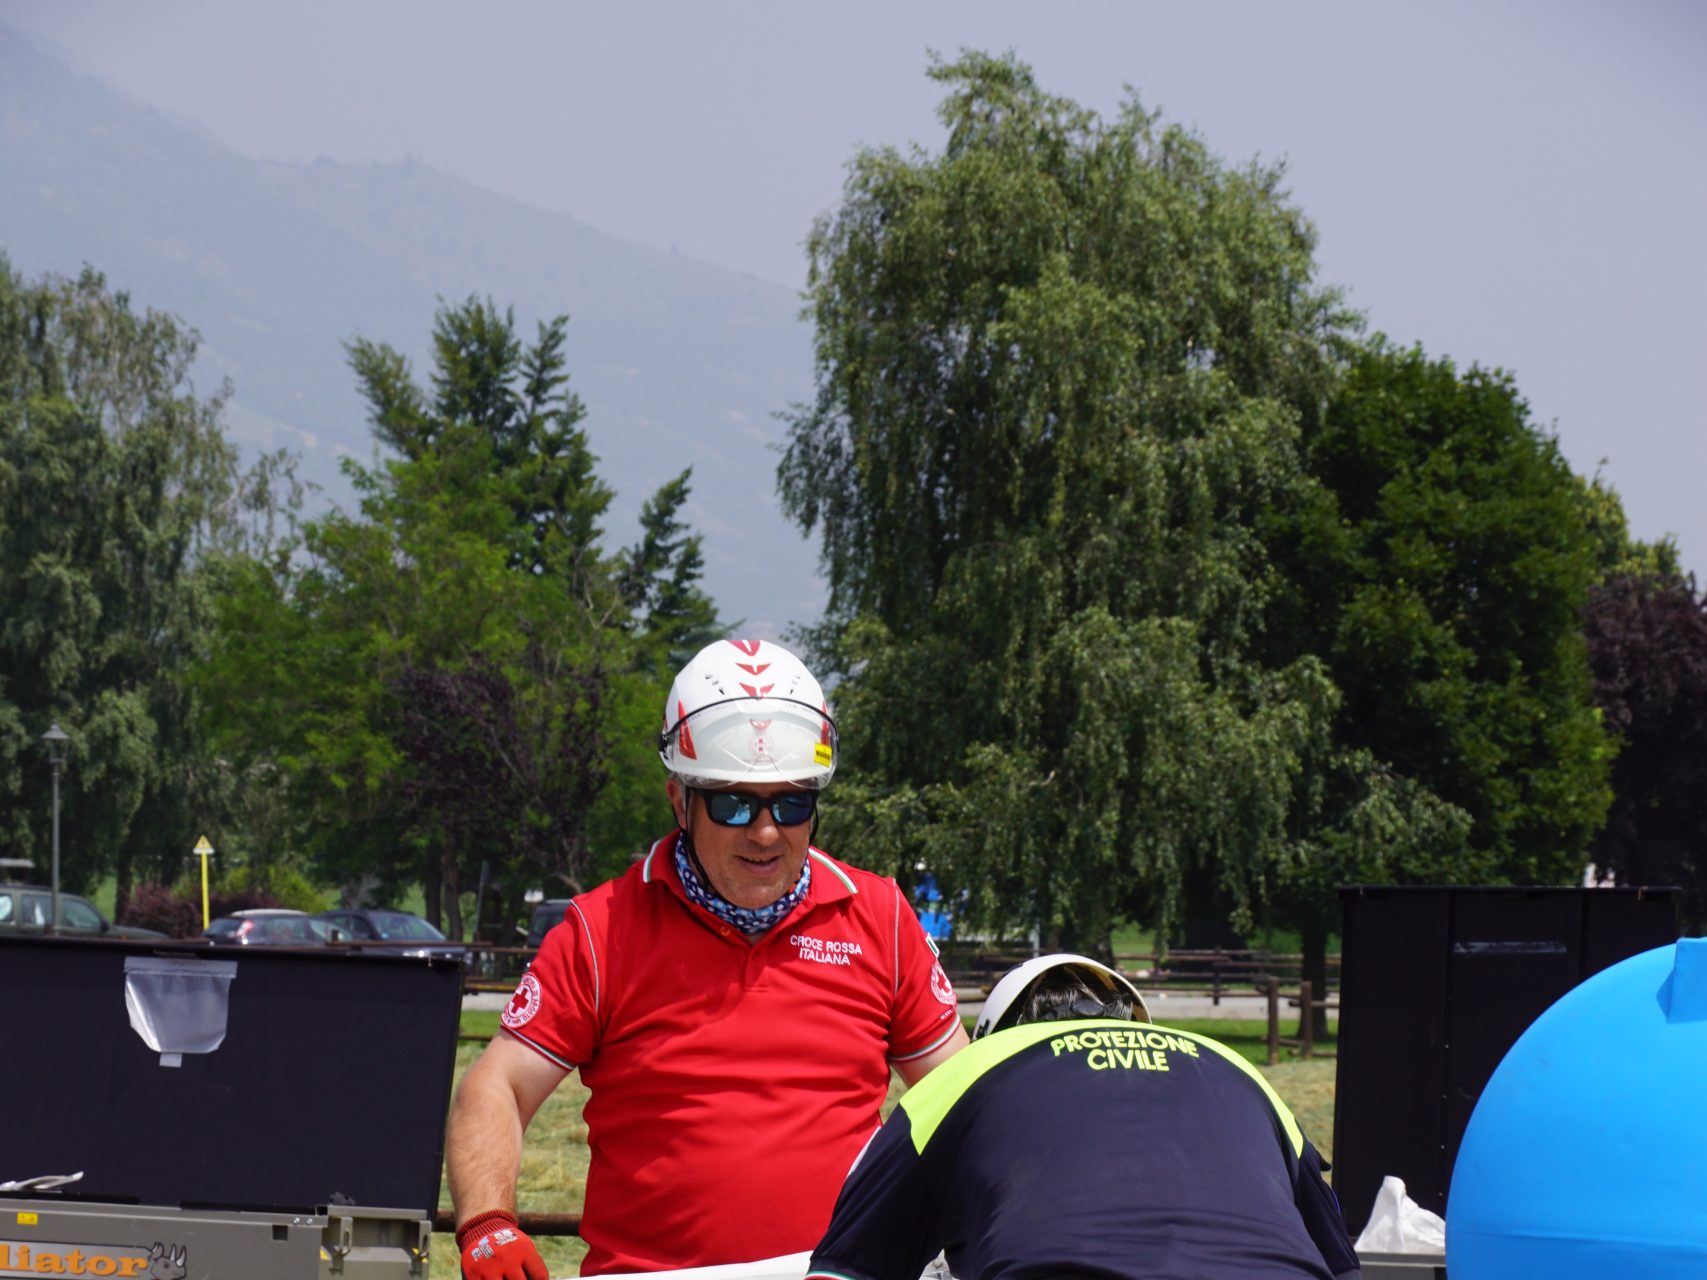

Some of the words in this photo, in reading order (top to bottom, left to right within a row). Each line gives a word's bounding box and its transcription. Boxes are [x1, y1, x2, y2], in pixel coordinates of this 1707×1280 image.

[790, 934, 823, 951] CROCE
[826, 940, 862, 956] ROSSA
[799, 947, 850, 966] ITALIANA
[1050, 1031, 1200, 1058] PROTEZIONE
[1087, 1048, 1170, 1072] CIVILE
